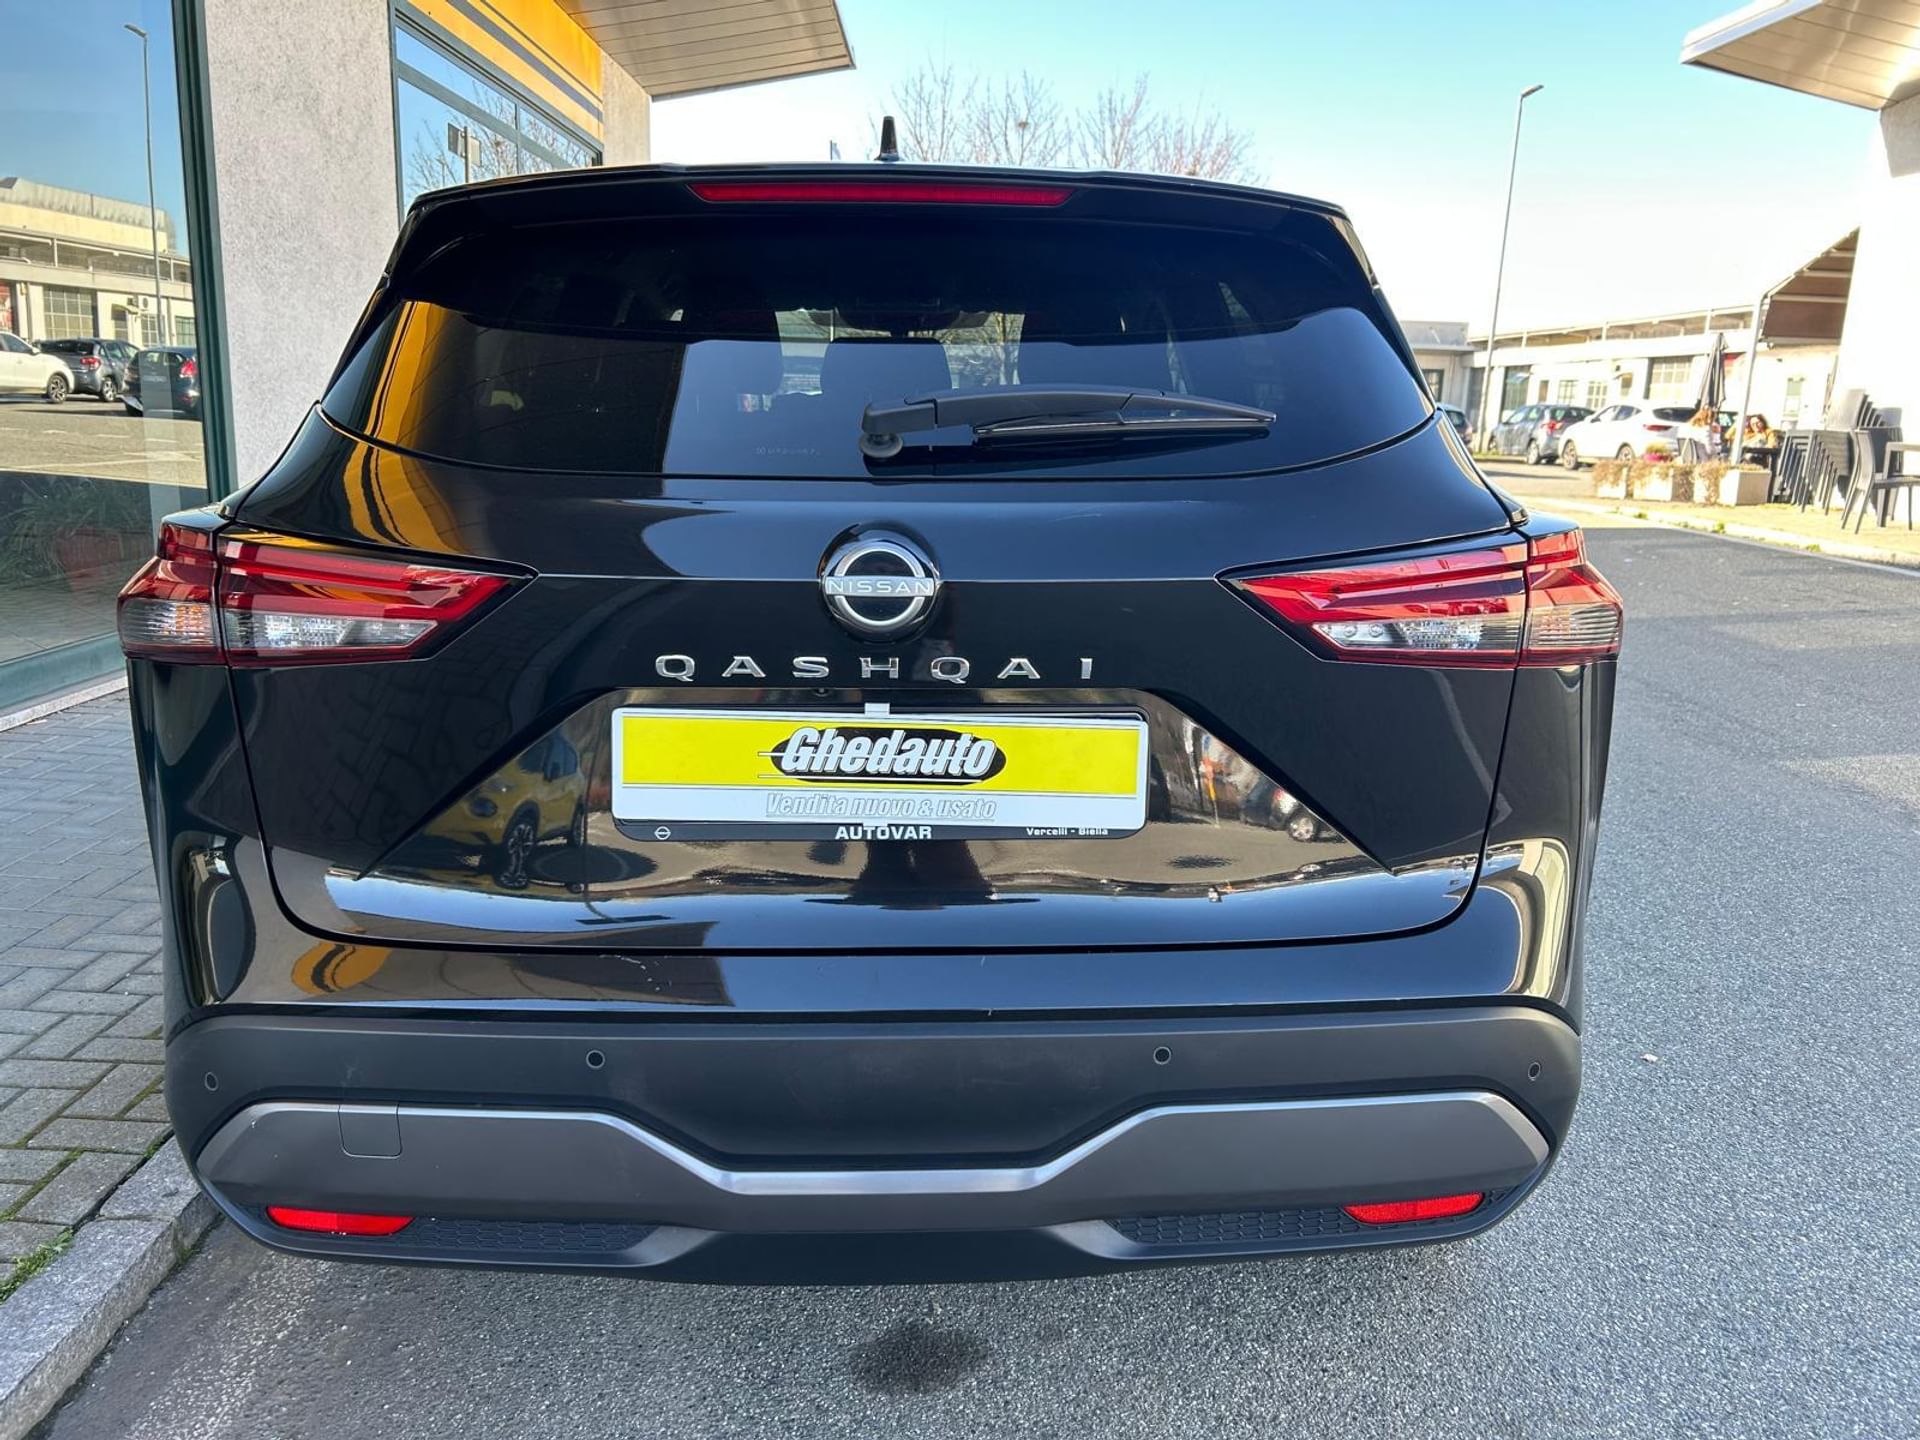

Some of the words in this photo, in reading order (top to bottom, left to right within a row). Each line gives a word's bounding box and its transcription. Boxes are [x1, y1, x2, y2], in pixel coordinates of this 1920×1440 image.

[828, 580, 931, 594] NISSAN
[655, 654, 1093, 684] QASHQAI
[781, 727, 996, 777] Ghedauto
[766, 792, 848, 817] Vendita
[850, 797, 915, 818] nuovo
[917, 799, 934, 818] &
[937, 798, 998, 820] usato
[835, 825, 932, 840] AUTOVAR
[1026, 827, 1068, 836] Vercelli
